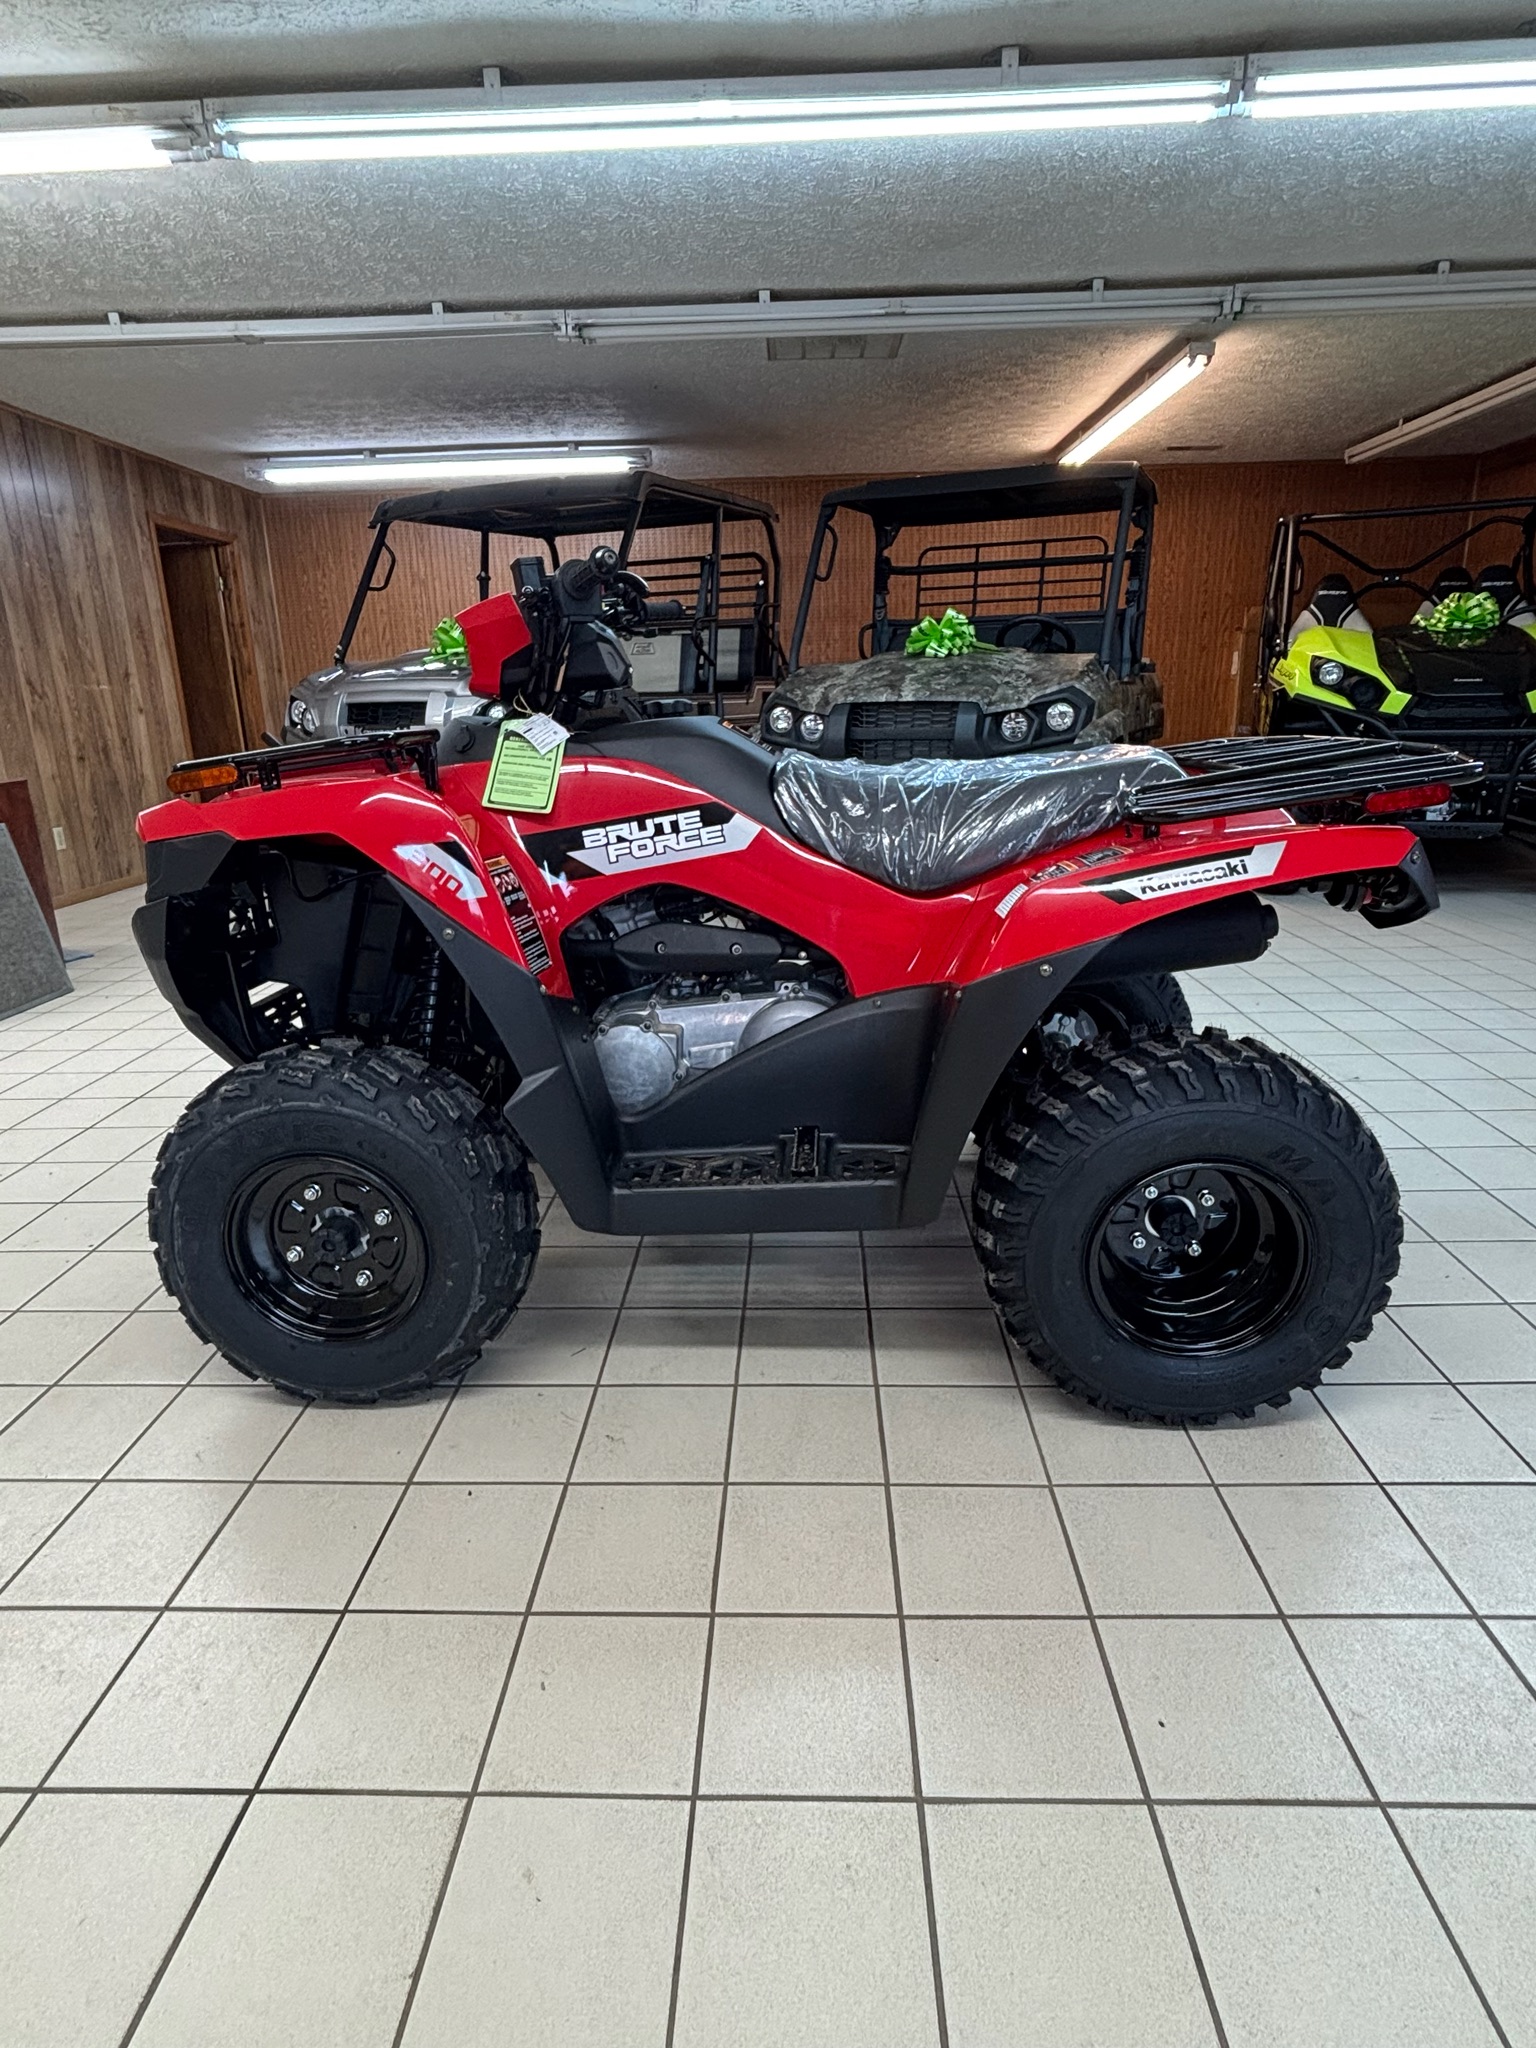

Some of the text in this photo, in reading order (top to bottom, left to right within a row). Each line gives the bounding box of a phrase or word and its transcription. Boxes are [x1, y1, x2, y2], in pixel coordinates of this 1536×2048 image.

[582, 810, 703, 849] BRUTE
[606, 825, 726, 864] FORCE
[1139, 859, 1249, 895] Kawasaki
